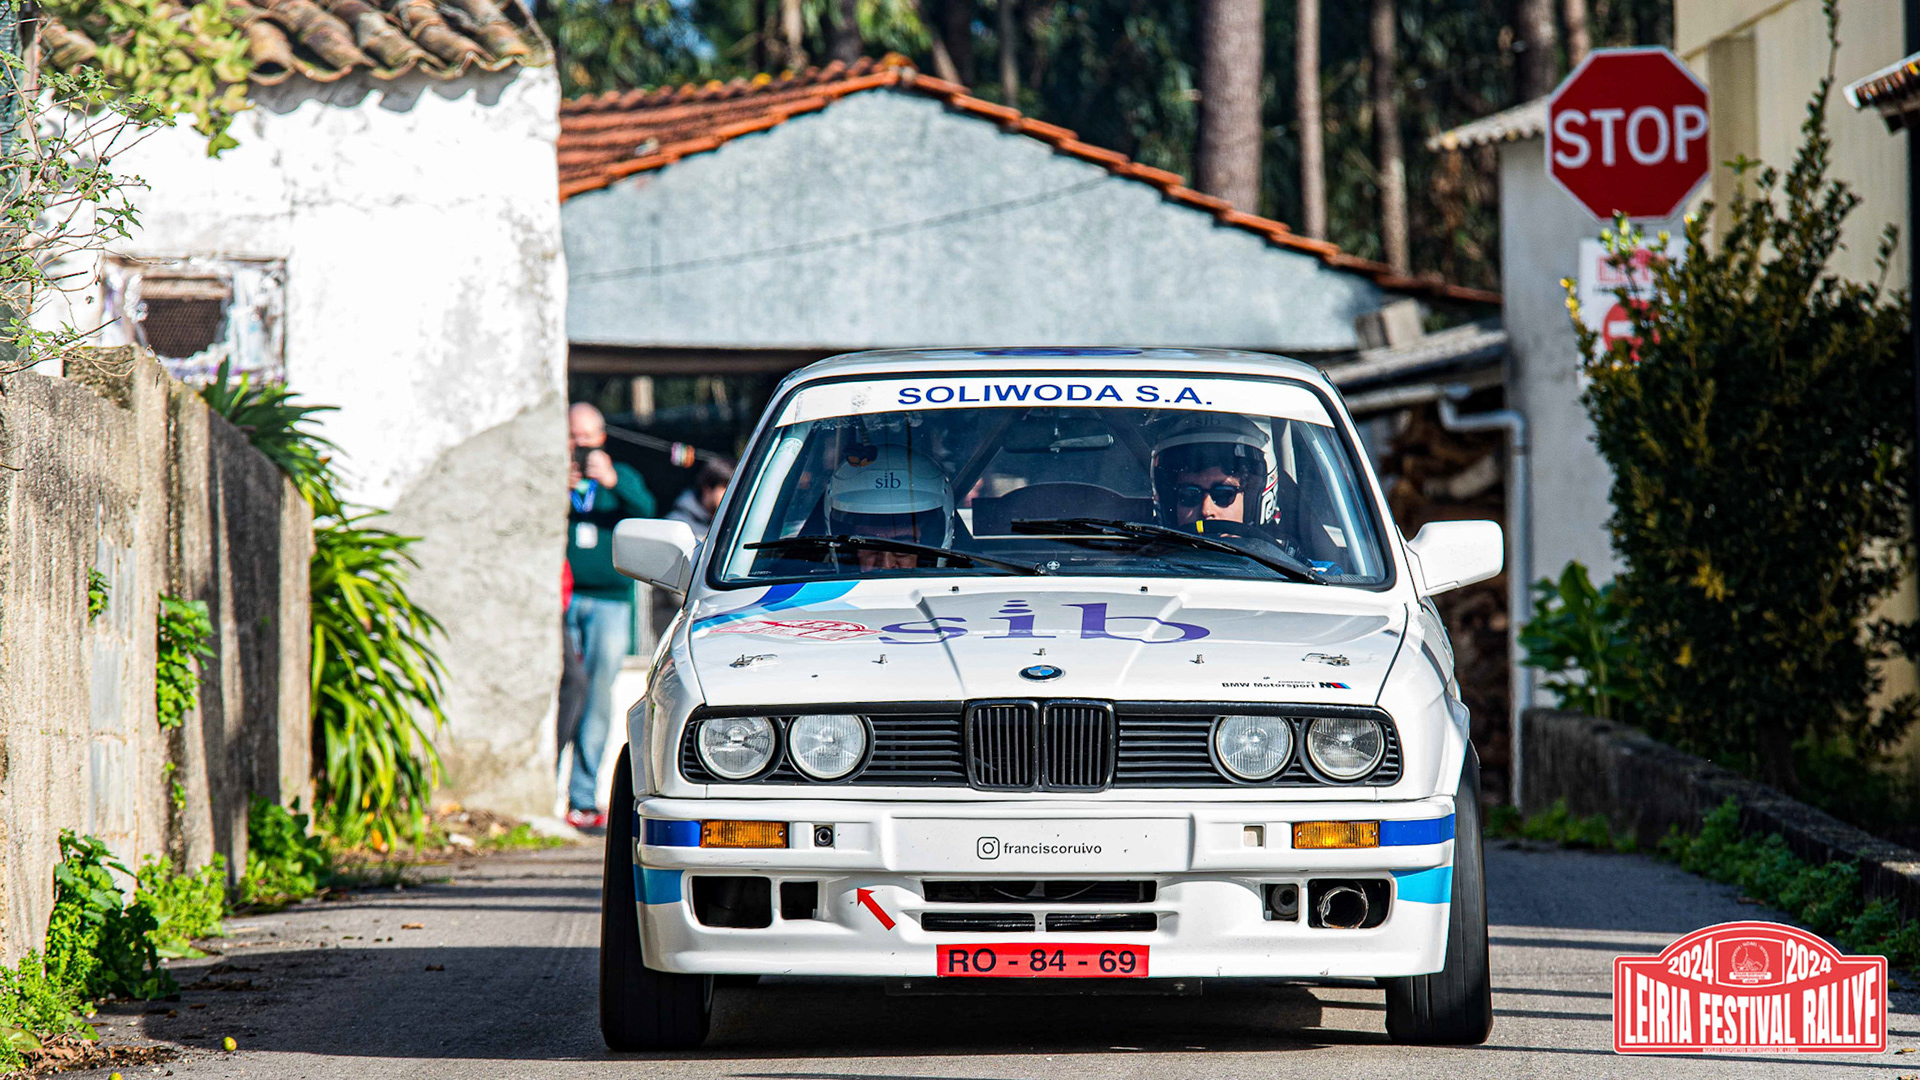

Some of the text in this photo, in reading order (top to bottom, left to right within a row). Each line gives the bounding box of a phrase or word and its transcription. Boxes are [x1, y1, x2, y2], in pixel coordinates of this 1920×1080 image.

[1554, 104, 1708, 168] STOP
[897, 384, 1213, 405] SOLIWODA S.A.
[1195, 414, 1221, 426] sib
[875, 472, 901, 489] sib
[879, 600, 1211, 644] sib
[1253, 681, 1316, 689] Motorsport
[1003, 842, 1102, 855] franciscoruivo
[948, 947, 997, 973] RO
[1029, 948, 1067, 973] 84
[1099, 949, 1137, 974] 69
